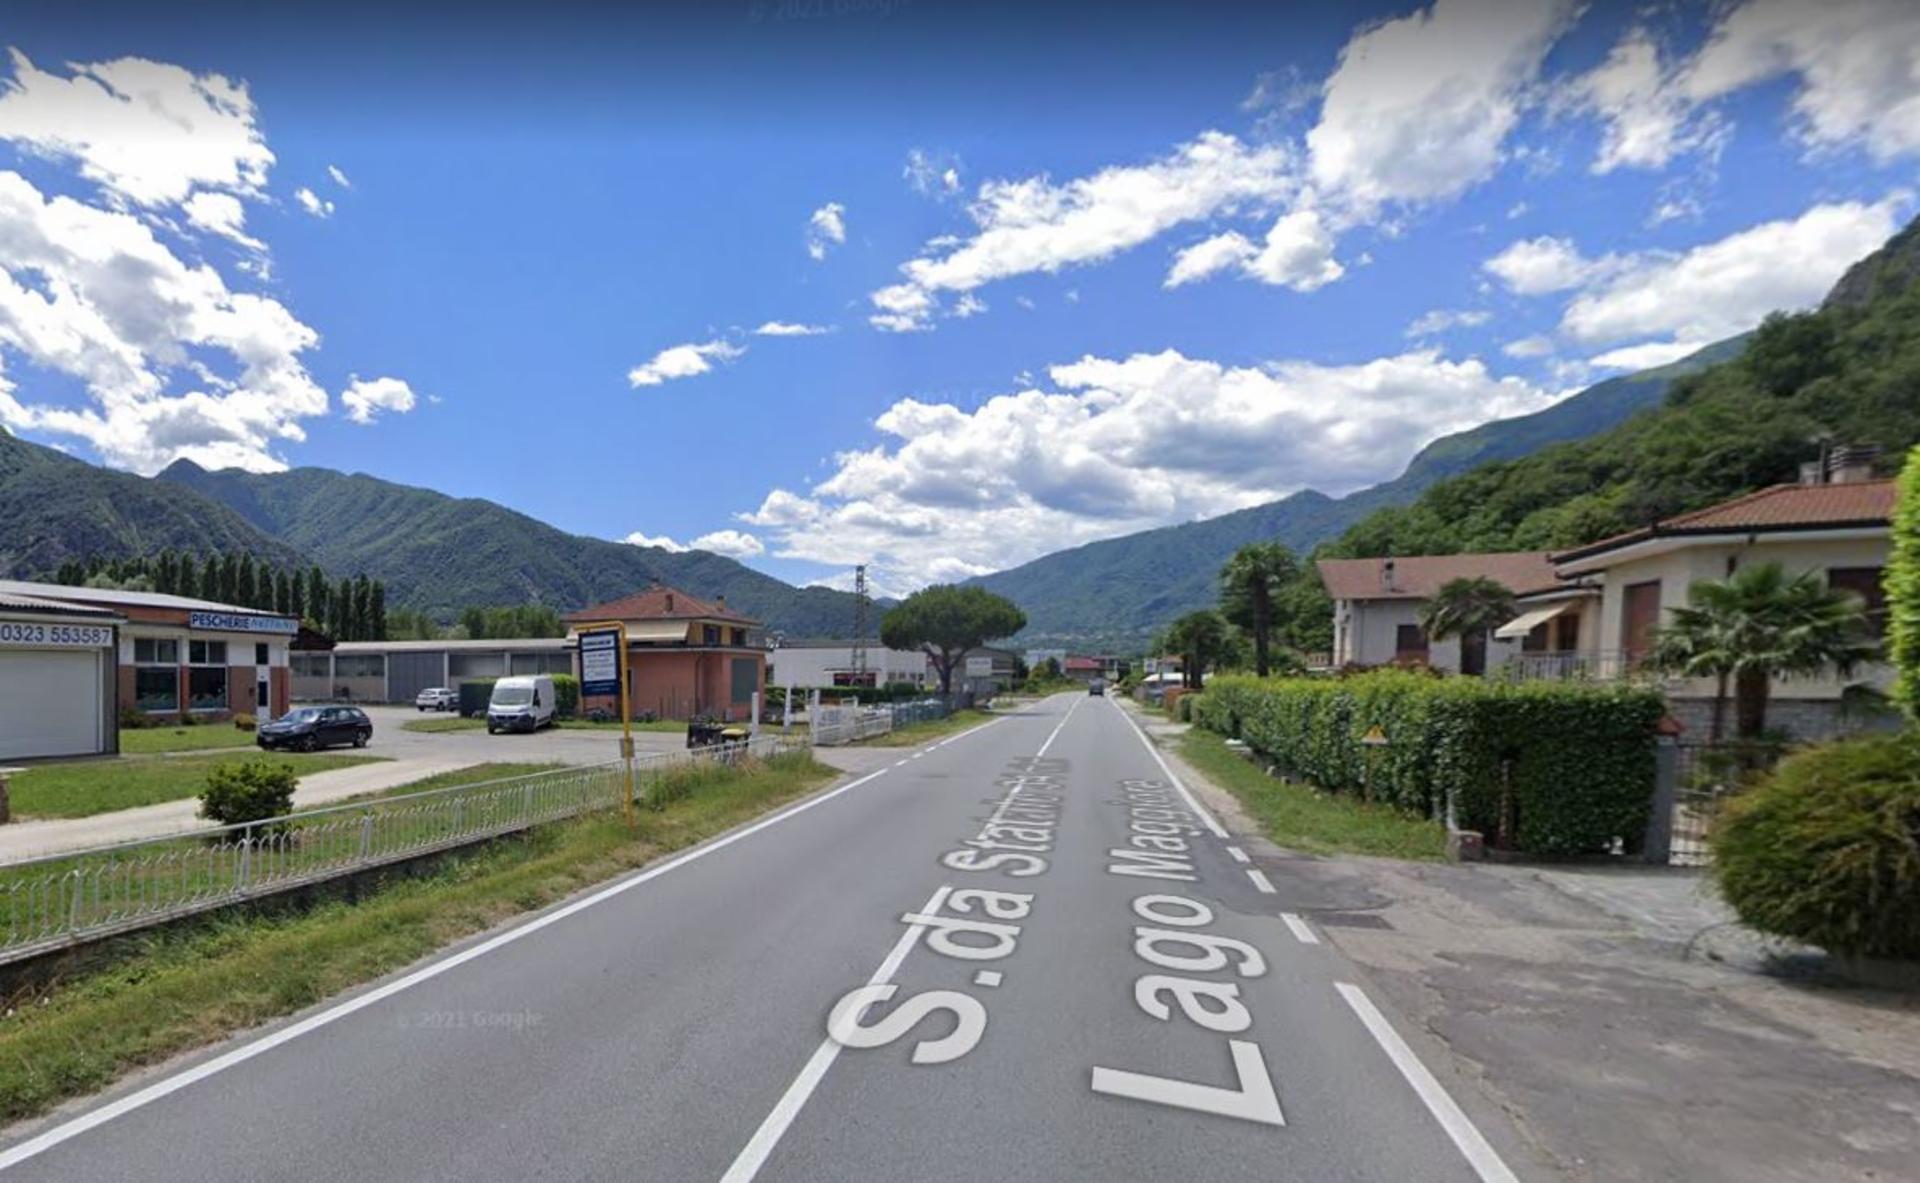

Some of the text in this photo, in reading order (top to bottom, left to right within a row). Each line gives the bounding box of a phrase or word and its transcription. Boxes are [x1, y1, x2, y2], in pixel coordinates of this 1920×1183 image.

[192, 613, 250, 629] PESCHERIE
[1, 624, 110, 644] 0323 553587
